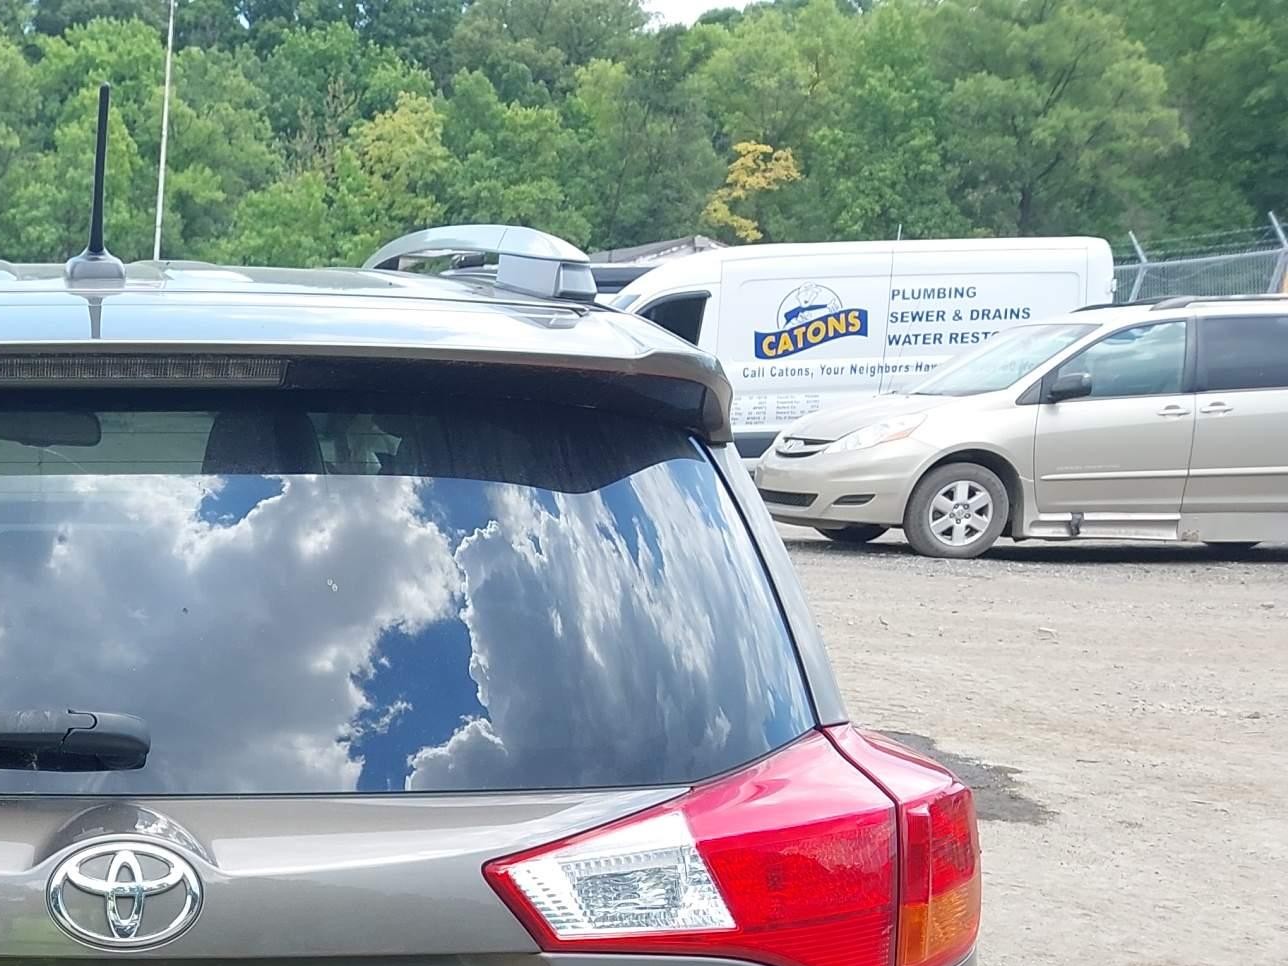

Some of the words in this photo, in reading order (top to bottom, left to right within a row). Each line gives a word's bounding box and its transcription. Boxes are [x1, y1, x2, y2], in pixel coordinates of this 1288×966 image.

[891, 286, 977, 300] PLUMBING
[889, 309, 946, 323] SEWER
[952, 309, 964, 321] &
[970, 307, 1031, 321] DRAINS
[762, 311, 861, 357] CATONS
[887, 332, 943, 346] WATER
[742, 367, 765, 378] Call
[770, 366, 814, 379] Catons,
[819, 364, 845, 376] Your
[850, 362, 910, 376] Neighbors
